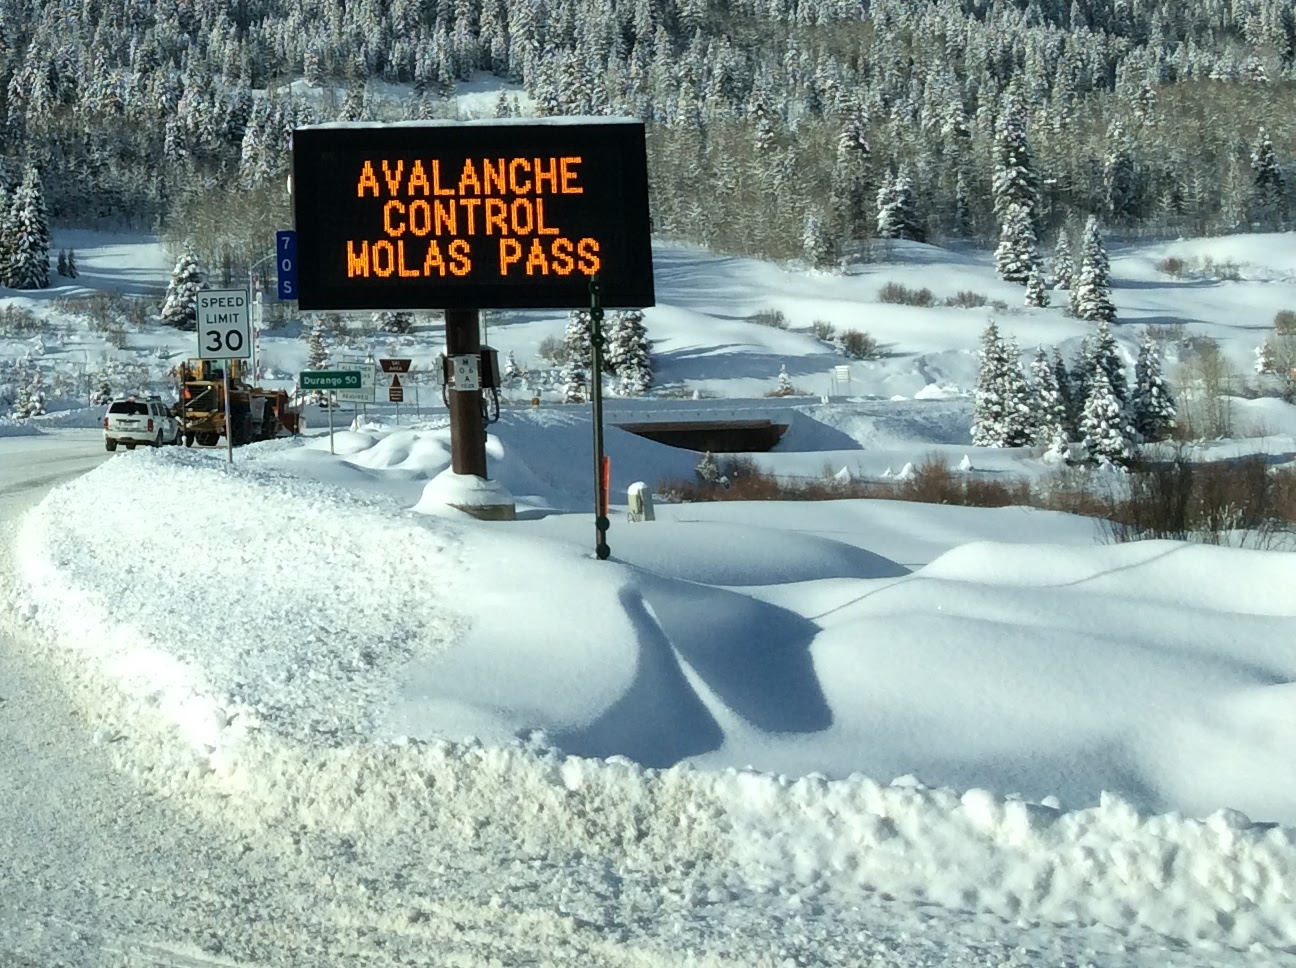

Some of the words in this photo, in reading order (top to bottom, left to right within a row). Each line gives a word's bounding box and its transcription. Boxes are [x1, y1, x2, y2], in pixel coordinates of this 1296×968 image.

[357, 156, 583, 197] AVALANCHE
[383, 198, 559, 236] CONTROL
[347, 239, 471, 277] MOLAS
[500, 238, 600, 275] PASS
[201, 297, 244, 308] SPEED
[206, 313, 240, 324] LIMIT
[206, 329, 243, 352] 30
[304, 376, 343, 386] Durango
[345, 375, 358, 384] 50
